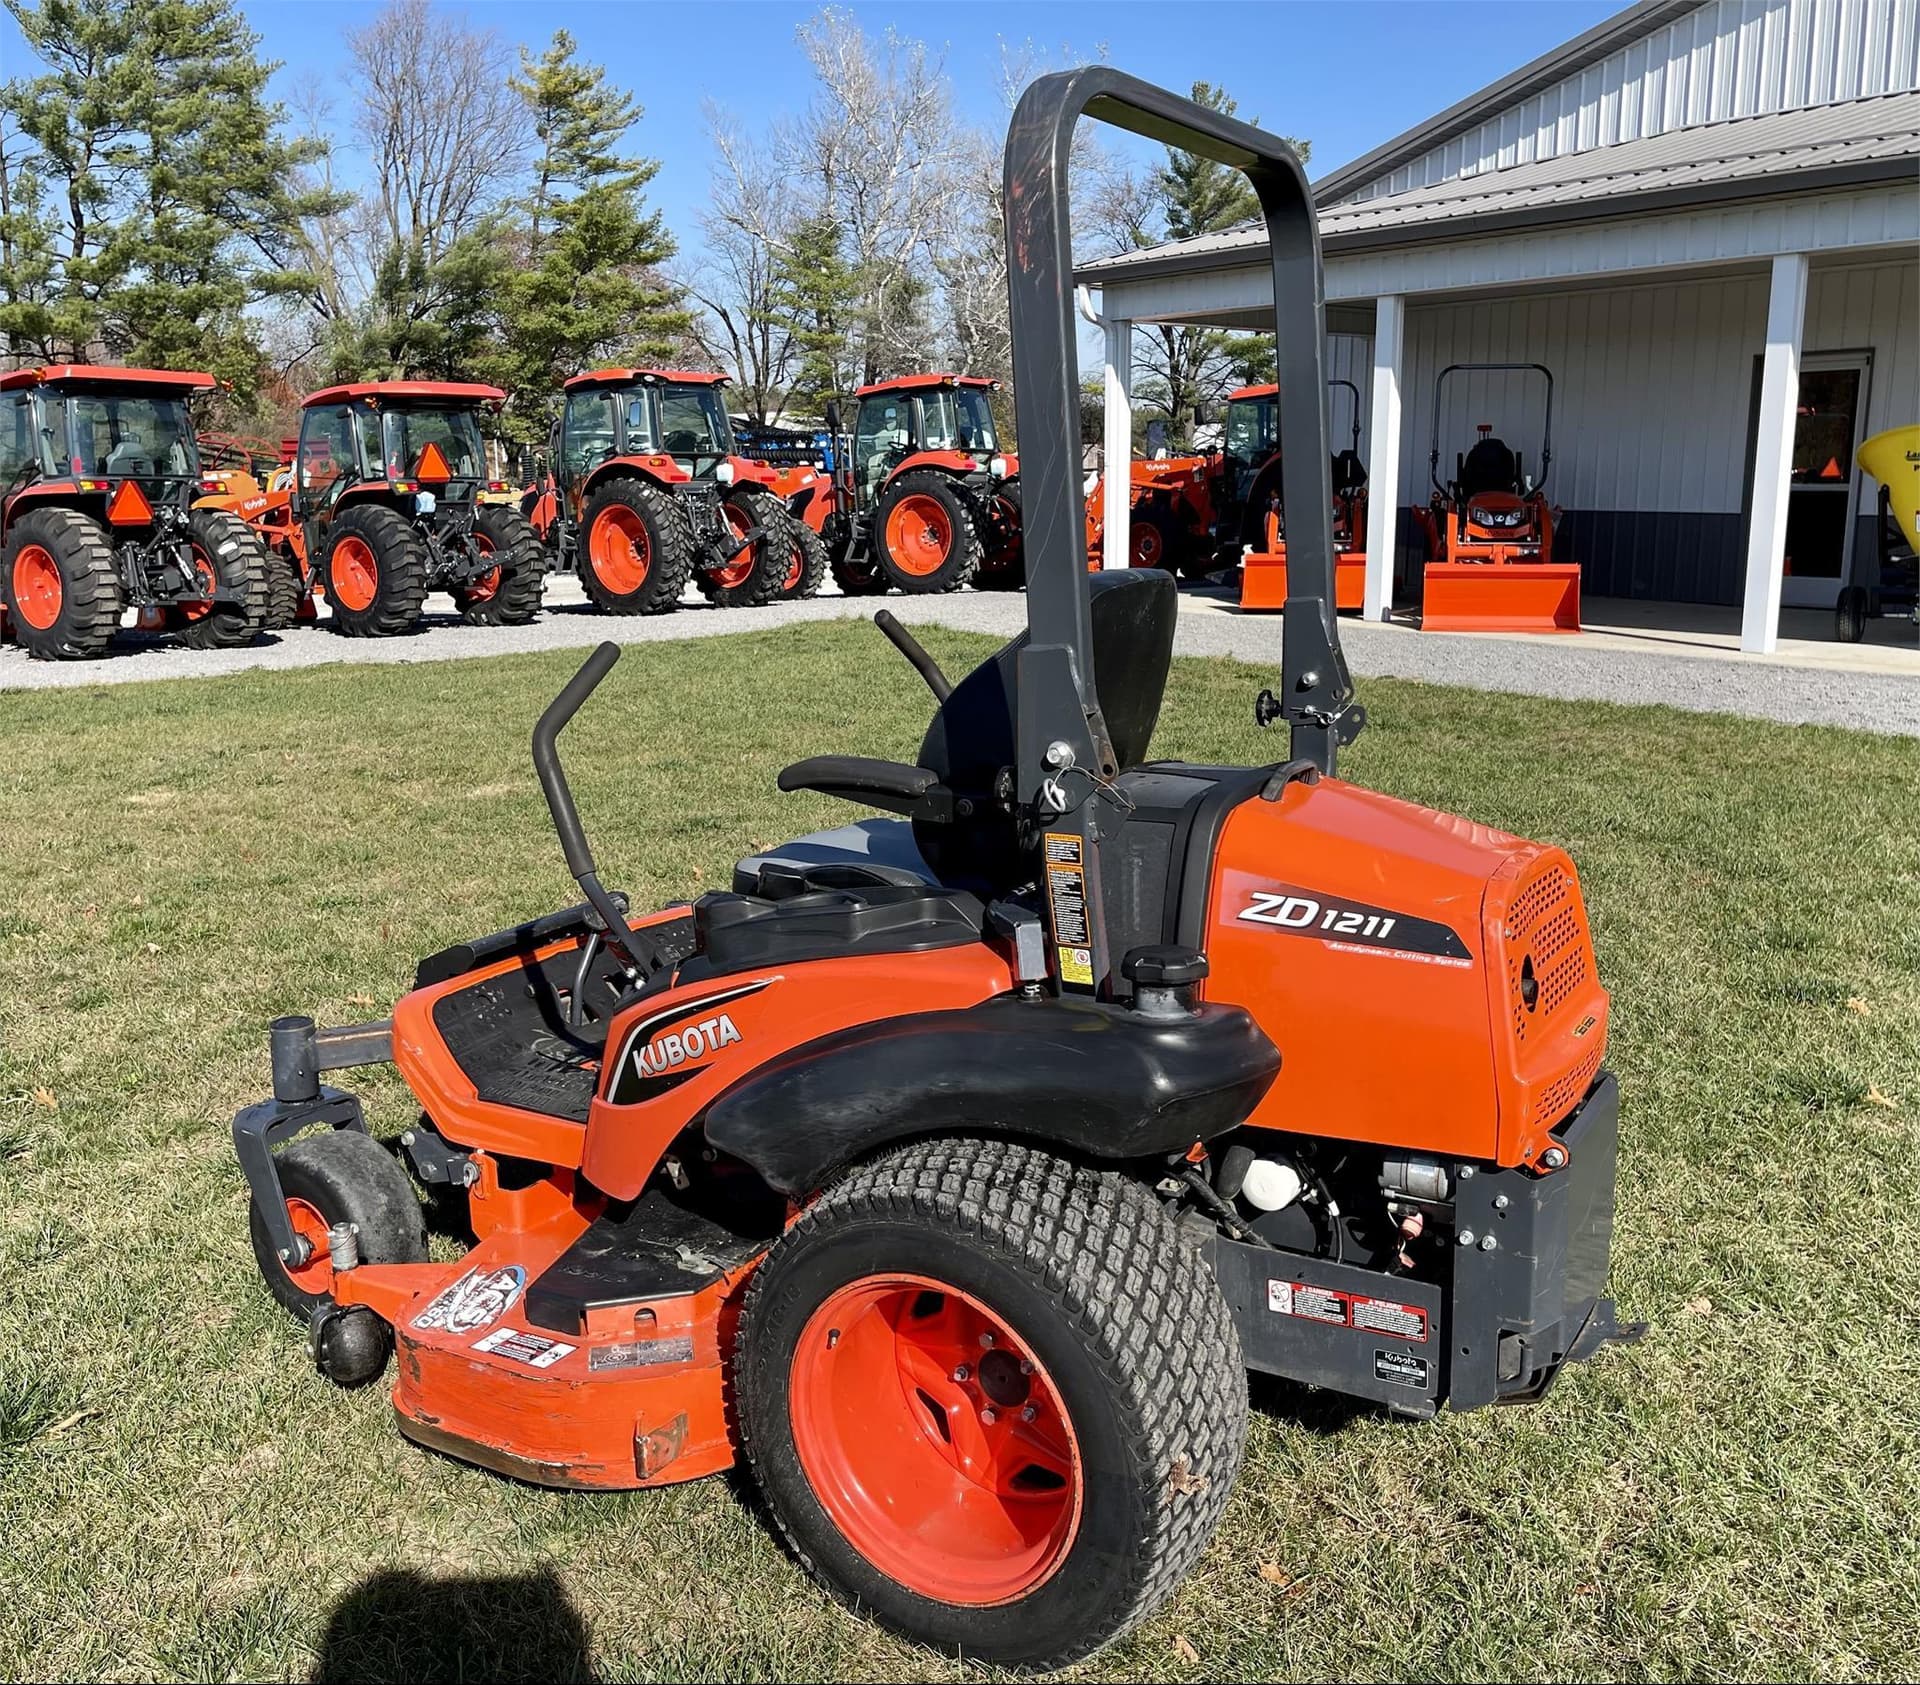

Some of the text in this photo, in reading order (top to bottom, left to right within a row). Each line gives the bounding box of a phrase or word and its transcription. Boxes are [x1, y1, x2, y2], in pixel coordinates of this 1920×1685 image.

[1237, 891, 1396, 939] ZD 1211
[1329, 942, 1470, 967] Aerodynamic Cutting System
[632, 1014, 742, 1079] KUBOTA
[1385, 1352, 1417, 1367] Kubota
